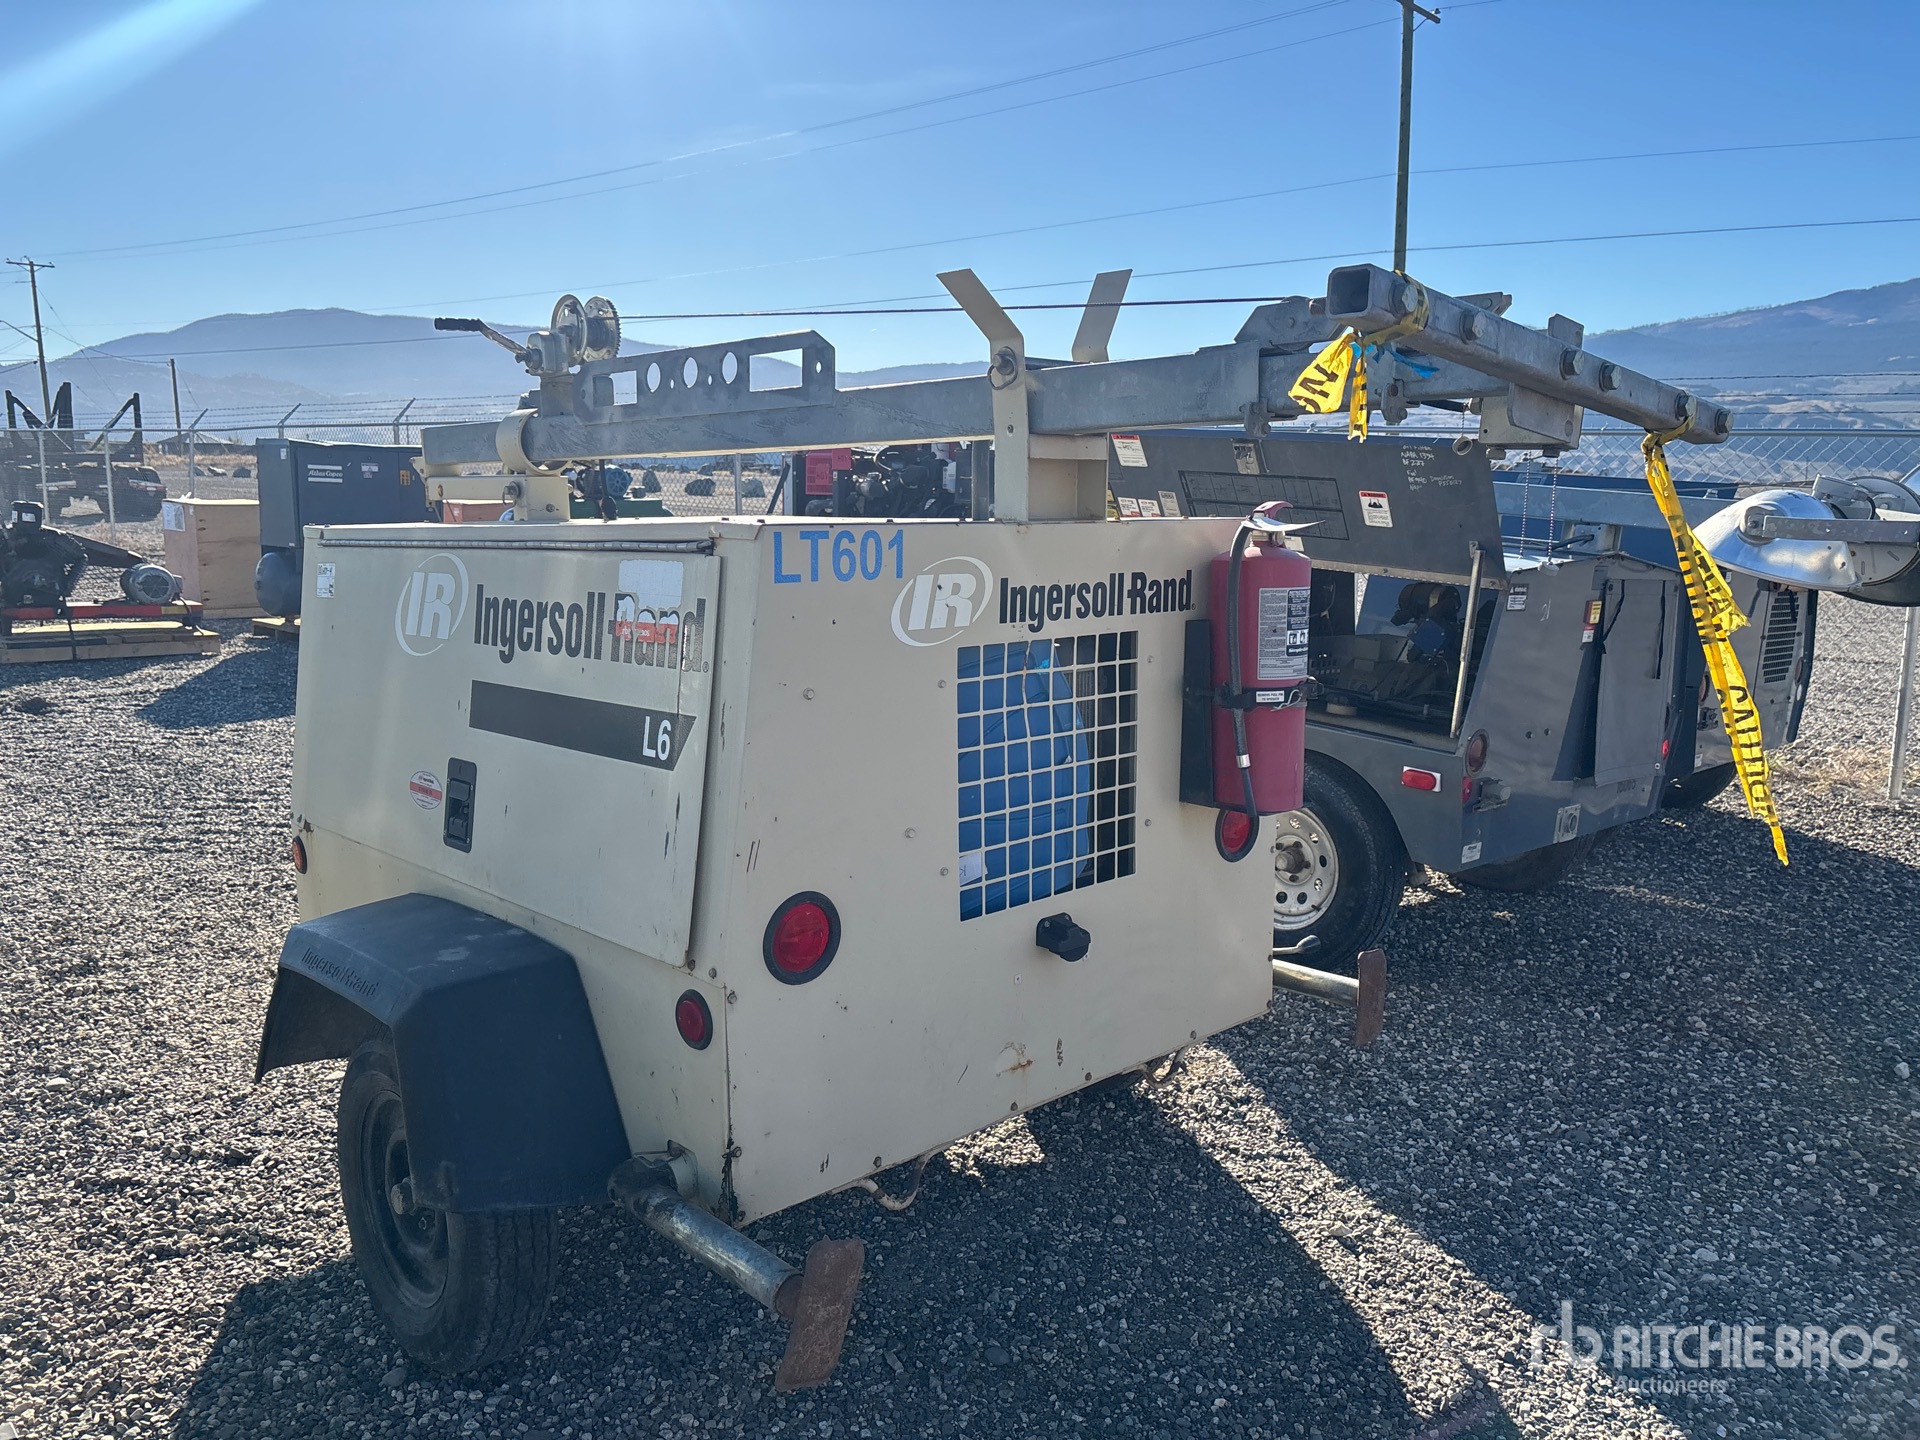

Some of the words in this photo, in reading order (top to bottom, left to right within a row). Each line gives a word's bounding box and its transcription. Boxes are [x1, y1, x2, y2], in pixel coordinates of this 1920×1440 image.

[309, 469, 325, 477] Atlas
[326, 470, 344, 478] Copco
[773, 529, 905, 584] LT601
[404, 571, 456, 640] IR
[907, 573, 977, 631] IR
[642, 715, 671, 761] L6
